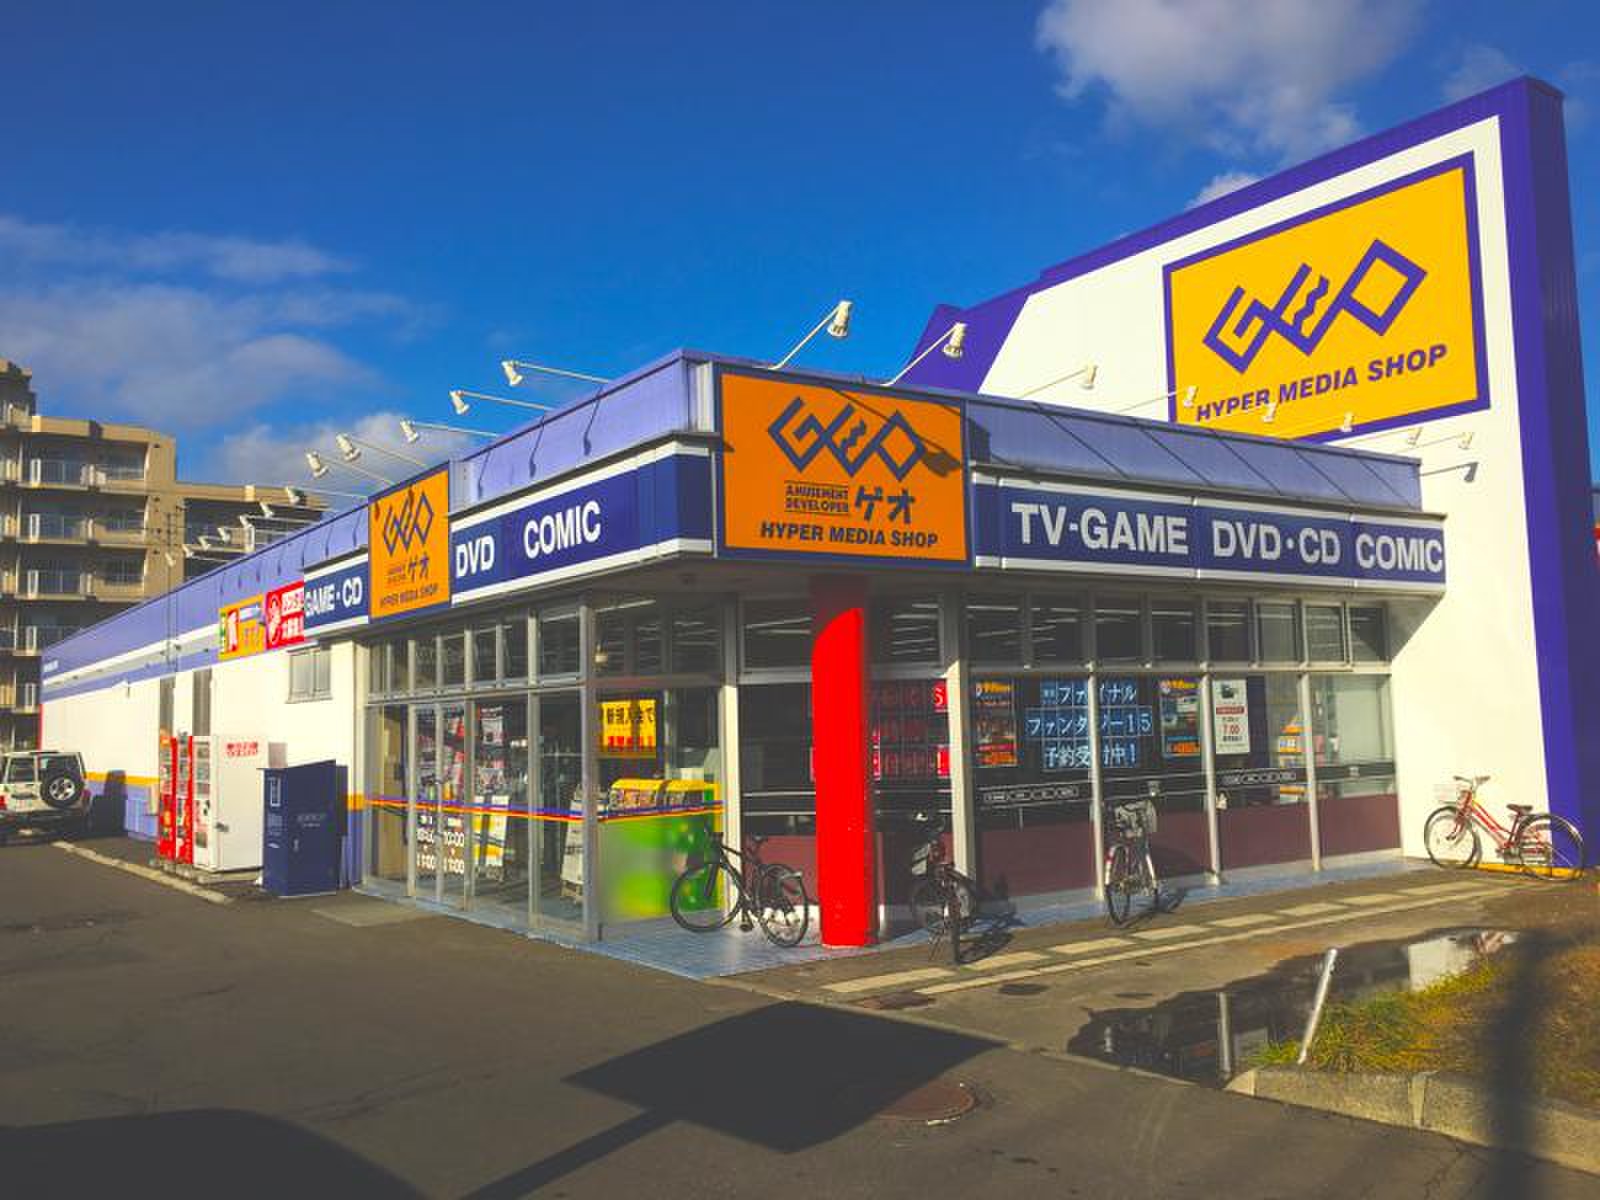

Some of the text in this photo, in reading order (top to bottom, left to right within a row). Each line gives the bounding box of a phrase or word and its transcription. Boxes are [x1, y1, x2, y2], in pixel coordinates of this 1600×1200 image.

[1196, 344, 1448, 421] HYPER MEDIA SHOP
[785, 485, 848, 499] AMUSEMENT
[785, 499, 848, 513] DEVELOPER
[855, 486, 915, 524] ゲオ
[456, 500, 601, 577] DVD COMIC
[761, 521, 938, 548] HYPER MEDIA SHOP
[1355, 532, 1444, 572] COMIC
